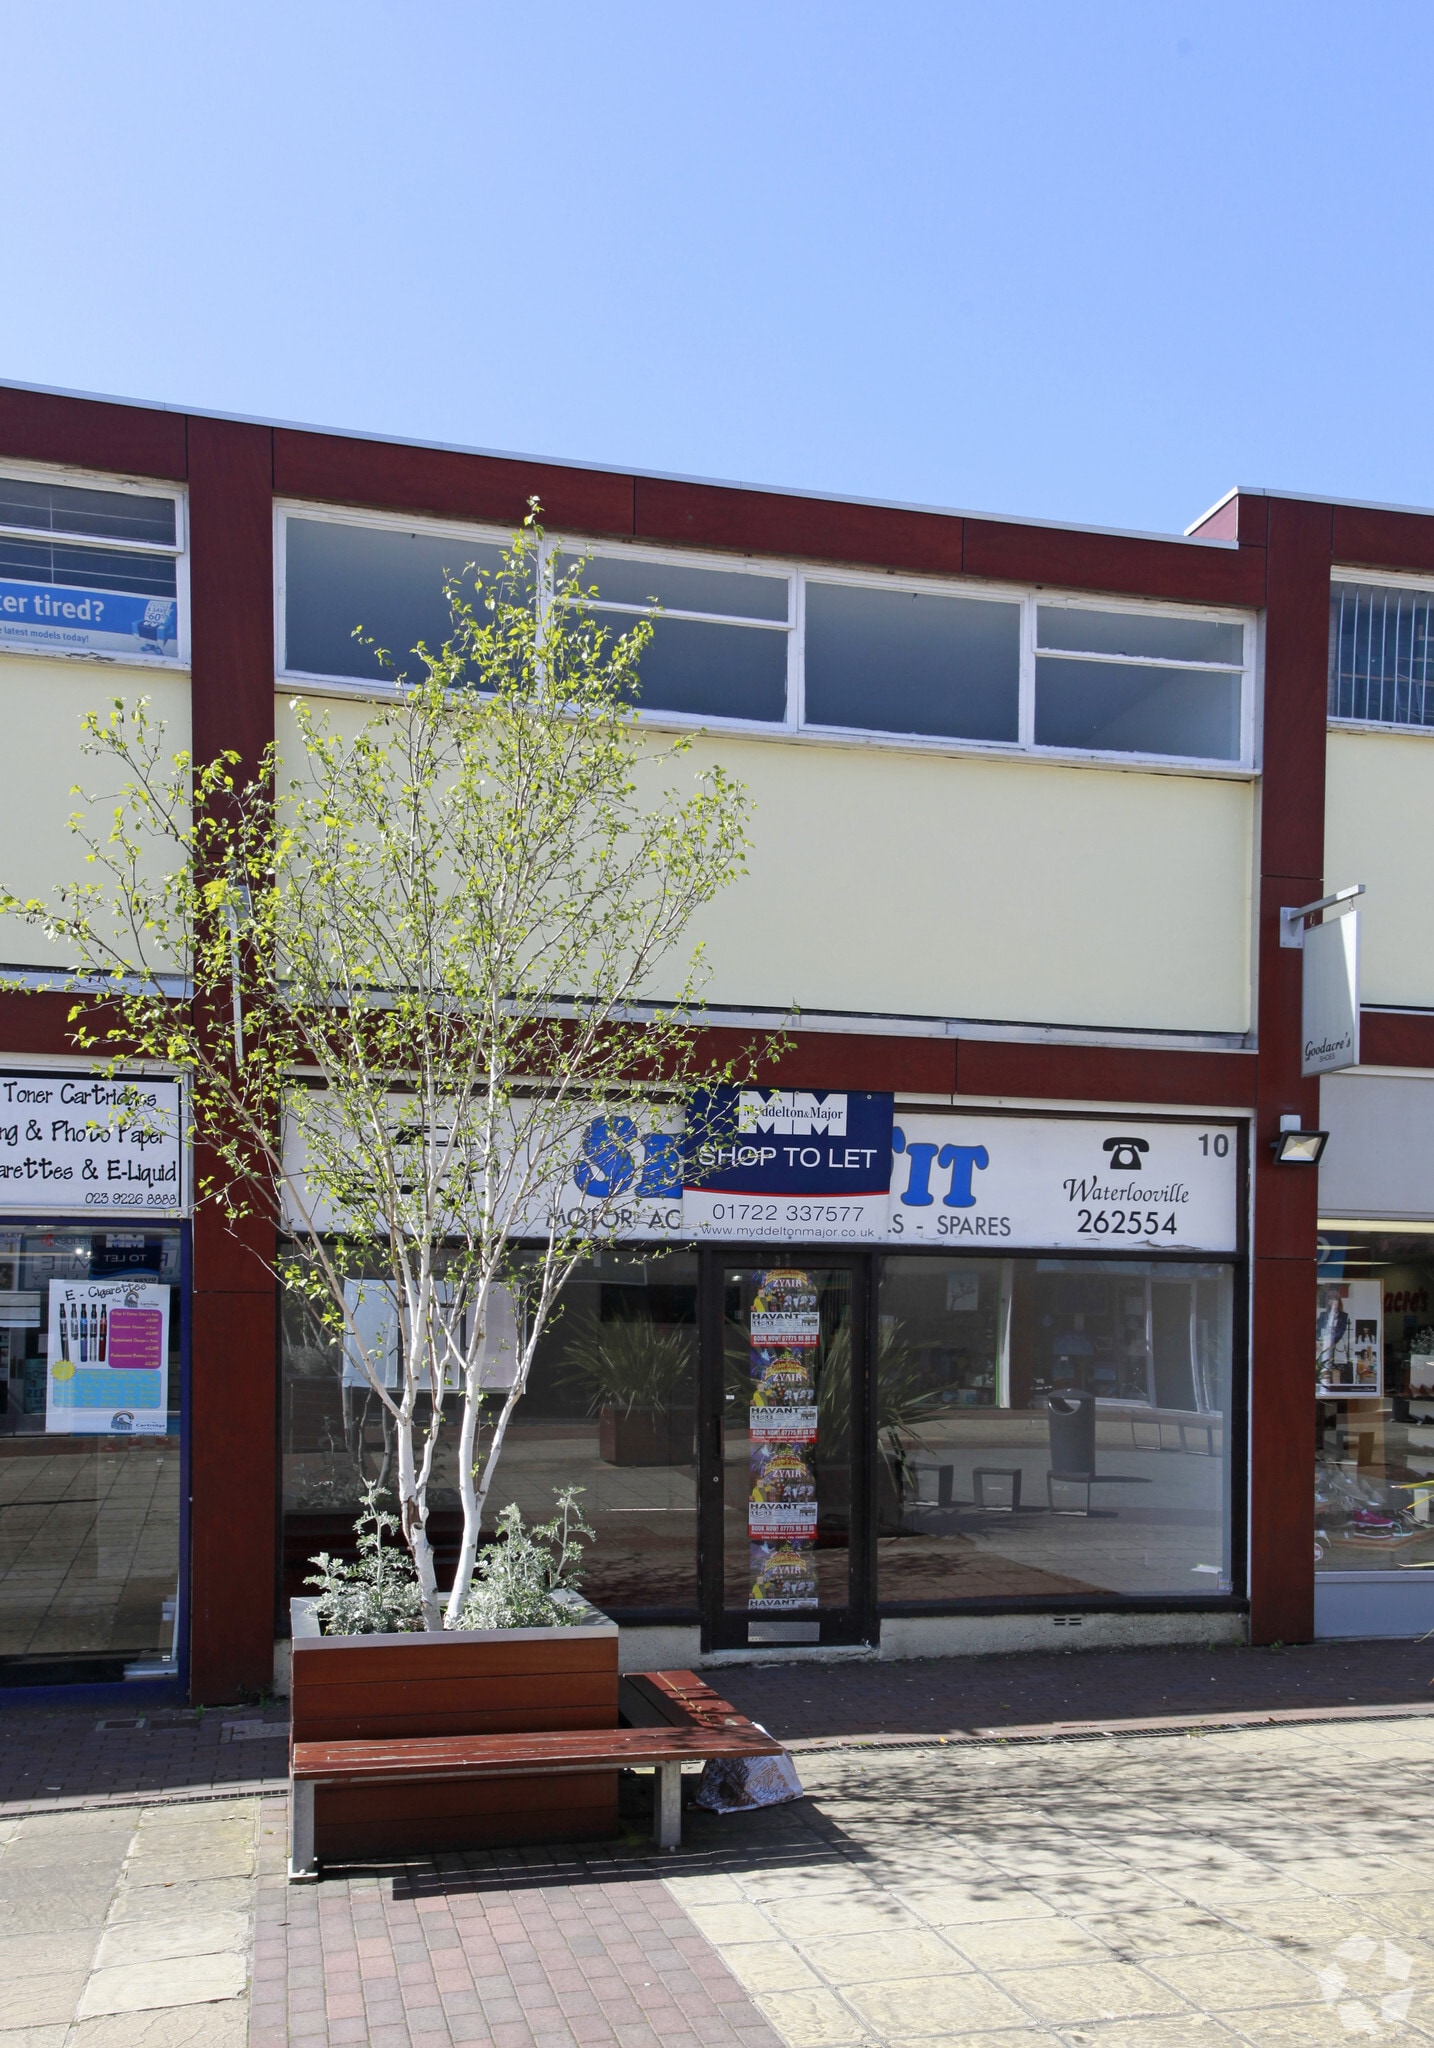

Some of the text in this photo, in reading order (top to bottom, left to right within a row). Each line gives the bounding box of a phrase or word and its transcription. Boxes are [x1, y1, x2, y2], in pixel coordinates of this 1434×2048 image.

[34, 594, 105, 622] tired?
[4, 626, 28, 636] latest
[30, 630, 61, 639] models
[63, 633, 89, 644] today!
[1304, 1032, 1351, 1062] Goodacre's
[3, 1081, 53, 1104] Toner
[0, 1124, 18, 1146] ng
[25, 1119, 43, 1141] &
[699, 1145, 878, 1169] SHOP TO LET
[1198, 1133, 1229, 1158] 10
[0, 1157, 177, 1188] arettes & E-Liquid
[892, 1126, 989, 1208] IT
[85, 1192, 177, 1205] 023 9226 8888
[1063, 1175, 1190, 1204] Waterlooville
[546, 1207, 633, 1229] MOTOR
[888, 1213, 905, 1234] S
[937, 1214, 1012, 1237] SPARES
[712, 1203, 865, 1222] 01722 337577
[1077, 1209, 1177, 1235] 262554
[701, 1225, 875, 1239] www.myddeltonmajor.co.uk
[65, 1290, 75, 1301] E
